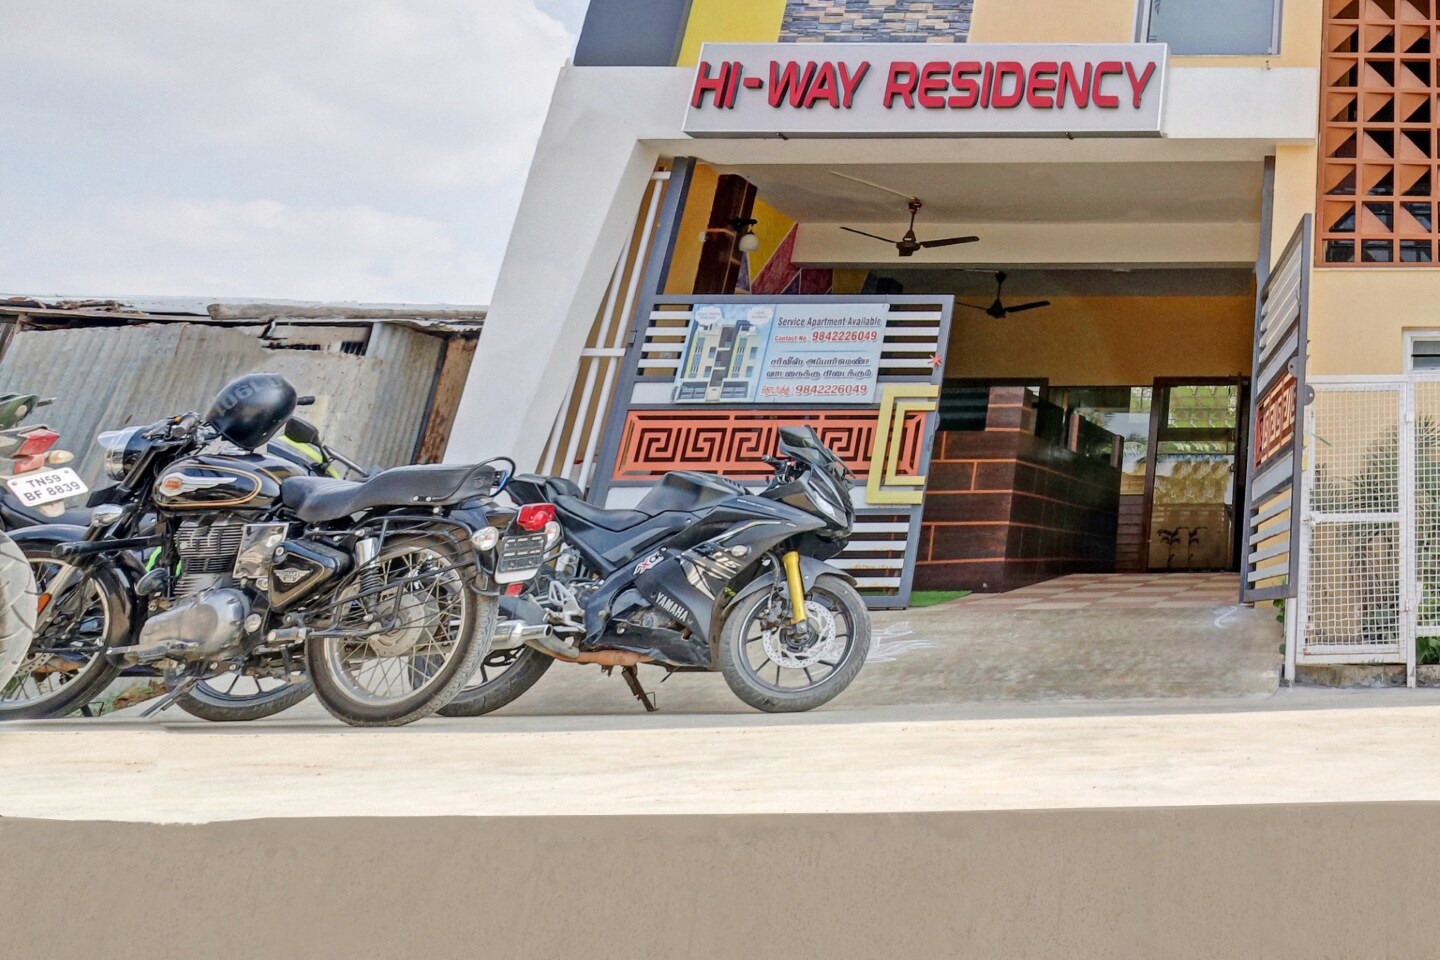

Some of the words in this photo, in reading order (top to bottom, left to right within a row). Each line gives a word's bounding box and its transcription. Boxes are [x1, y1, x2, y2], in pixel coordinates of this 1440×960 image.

[692, 60, 871, 109] HI-WAY
[883, 60, 1157, 109] RESIDENCY
[777, 316, 805, 326] Service
[807, 317, 845, 328] Apartment
[847, 316, 882, 326] Available
[812, 330, 878, 341] 9842226049
[795, 384, 868, 395] 9842226049
[25, 474, 62, 488] TN59
[24, 490, 43, 501] BF
[46, 481, 81, 496] 8839
[655, 591, 688, 622] YAMAHA
